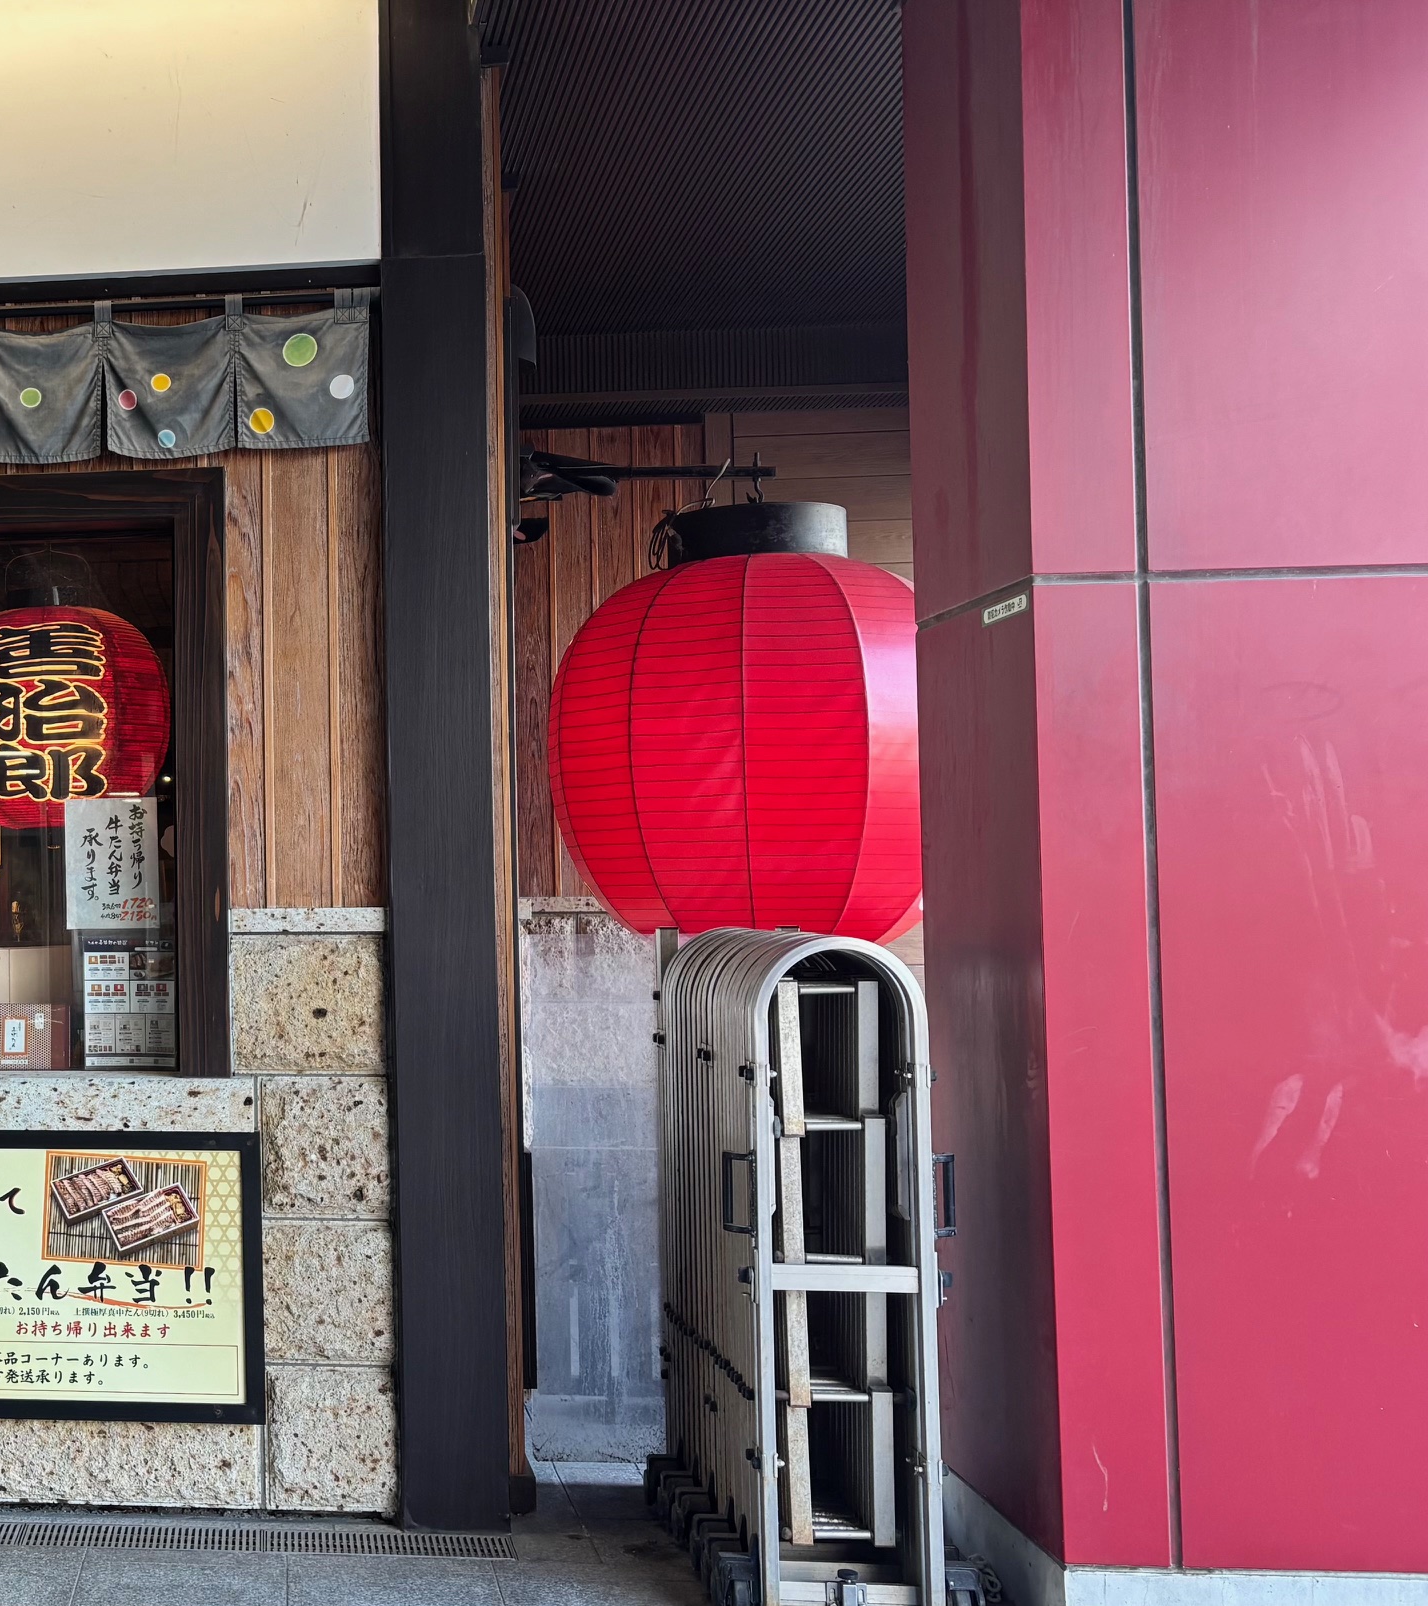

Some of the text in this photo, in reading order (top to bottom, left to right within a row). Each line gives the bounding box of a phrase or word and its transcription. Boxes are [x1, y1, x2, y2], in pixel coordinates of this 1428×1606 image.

[80, 828, 103, 901] 承ります。
[105, 815, 123, 895] 牛たん弁当
[128, 804, 148, 889] お持ち帰り
[15, 1320, 171, 1339] お持ち帰り出来ます
